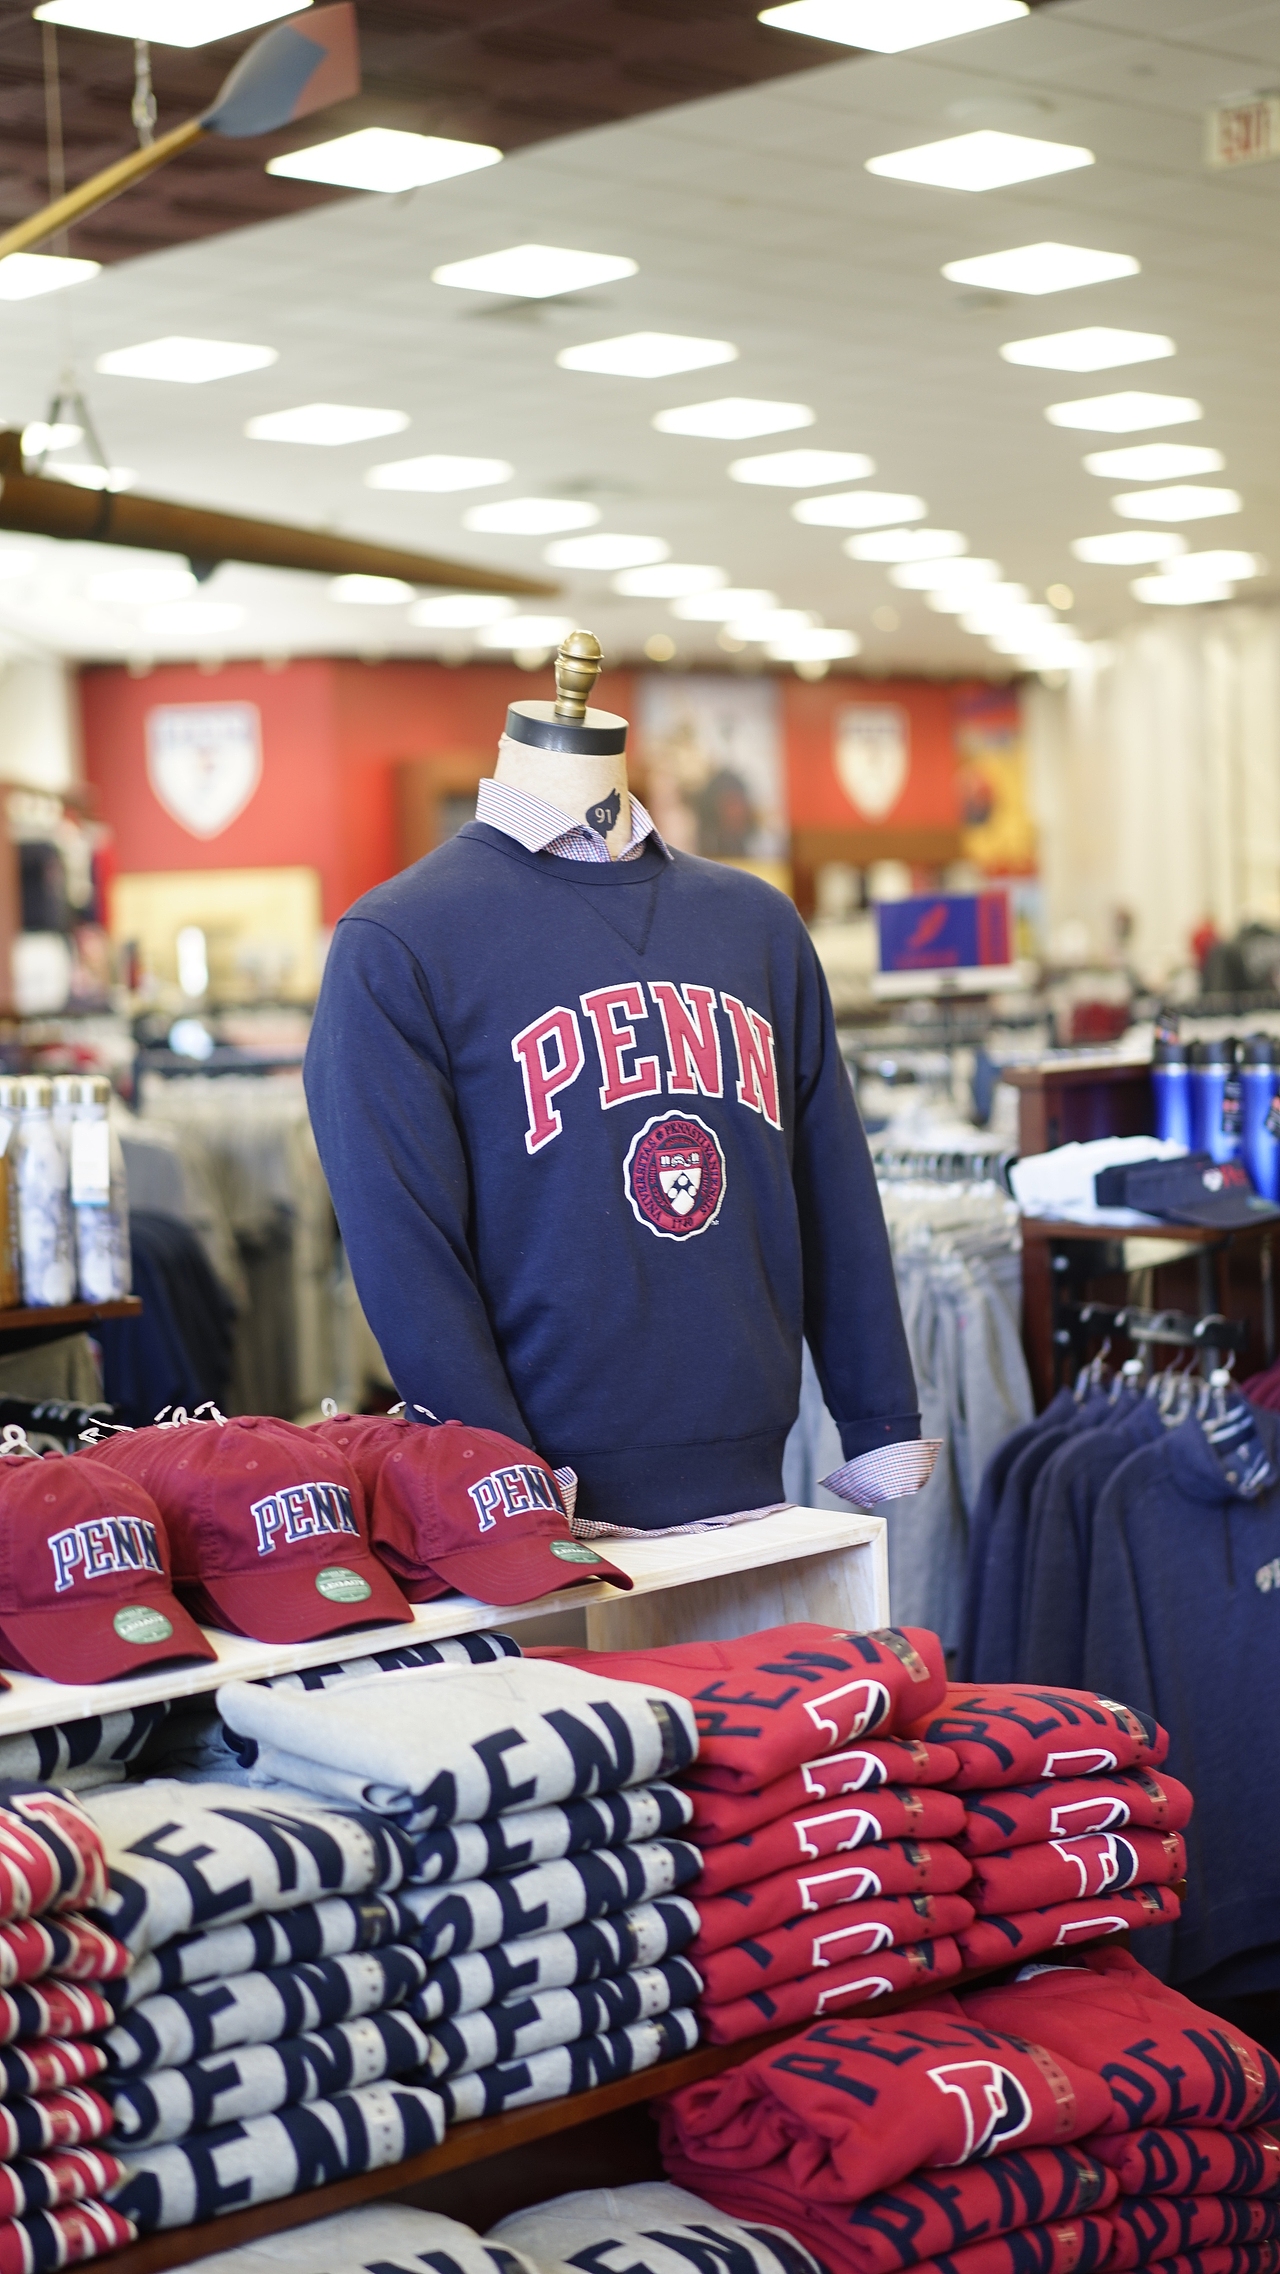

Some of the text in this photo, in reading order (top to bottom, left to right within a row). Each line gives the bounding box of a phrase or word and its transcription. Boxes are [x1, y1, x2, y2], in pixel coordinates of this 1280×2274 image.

[595, 808, 614, 825] 91
[511, 981, 784, 1155] PENN
[48, 1516, 165, 1593] PENN
[250, 1481, 361, 1557] PENN
